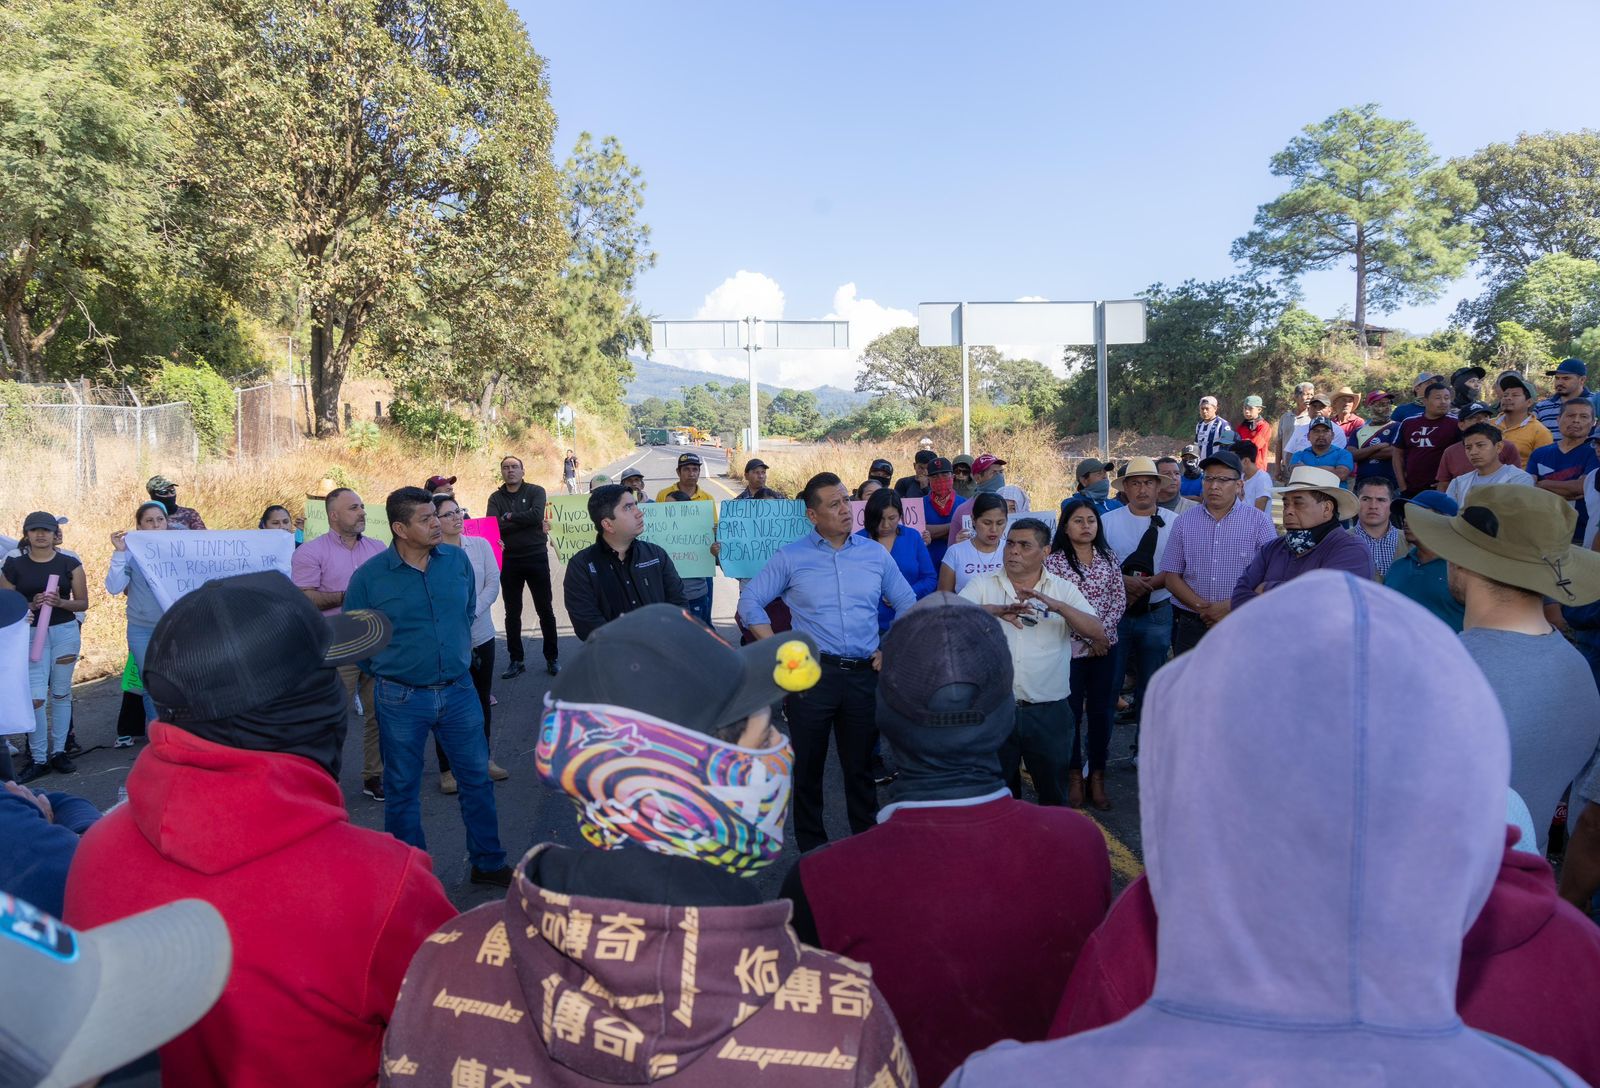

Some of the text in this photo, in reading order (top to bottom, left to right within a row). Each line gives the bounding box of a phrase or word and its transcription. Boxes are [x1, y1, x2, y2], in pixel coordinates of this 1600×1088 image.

[664, 505, 676, 518] NO
[680, 505, 700, 517] HAGA
[720, 500, 807, 518] EXIGIMOS JUSTIC
[719, 518, 814, 539] PARA NUESTROS
[145, 539, 250, 559] SI NO TENEMOS
[719, 539, 792, 561] DESAPAREC
[186, 558, 250, 576] RESPUESTA
[433, 988, 524, 1024] legends
[717, 1037, 858, 1070] legends
